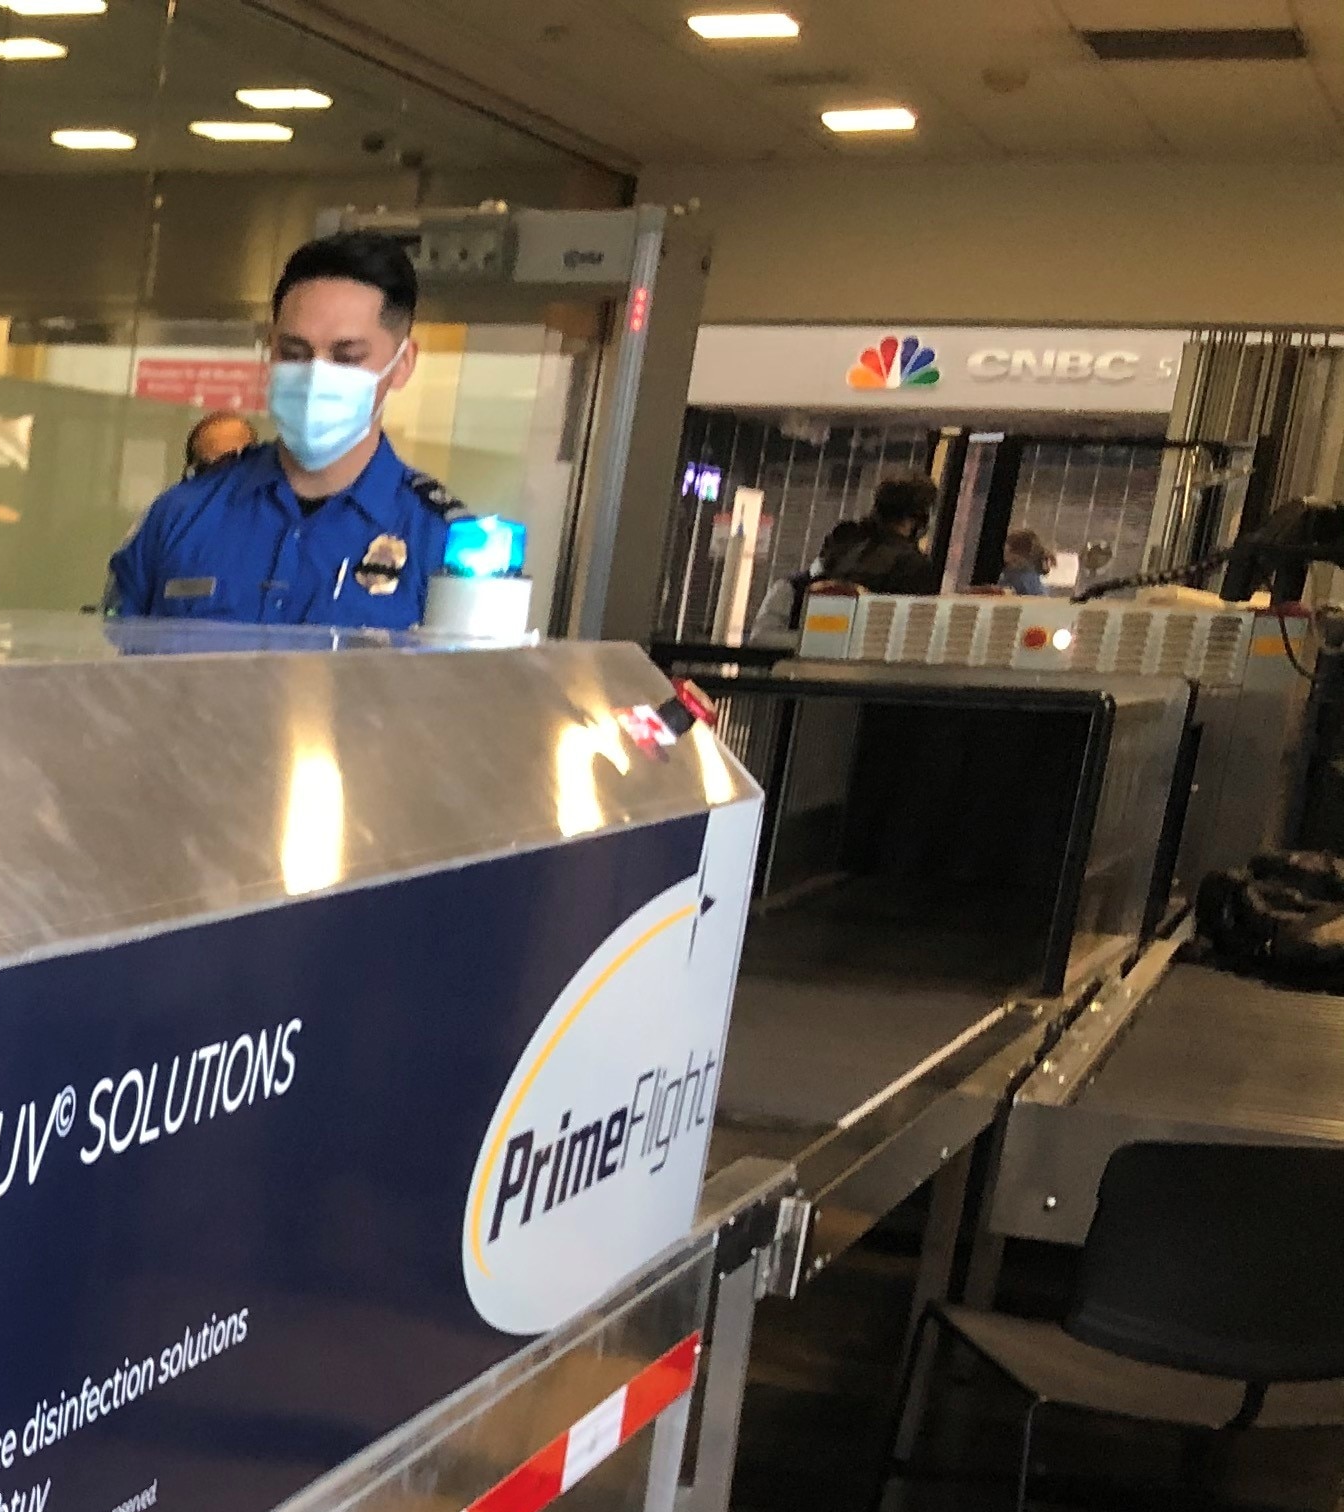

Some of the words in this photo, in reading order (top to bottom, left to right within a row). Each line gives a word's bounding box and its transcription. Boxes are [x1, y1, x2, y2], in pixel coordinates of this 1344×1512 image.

[967, 349, 1139, 380] CNBC
[80, 1018, 302, 1164] SOLUTIONS
[487, 1049, 715, 1244] PrimeFlight
[22, 1357, 154, 1457] disinfection
[158, 1307, 249, 1385] solutions
